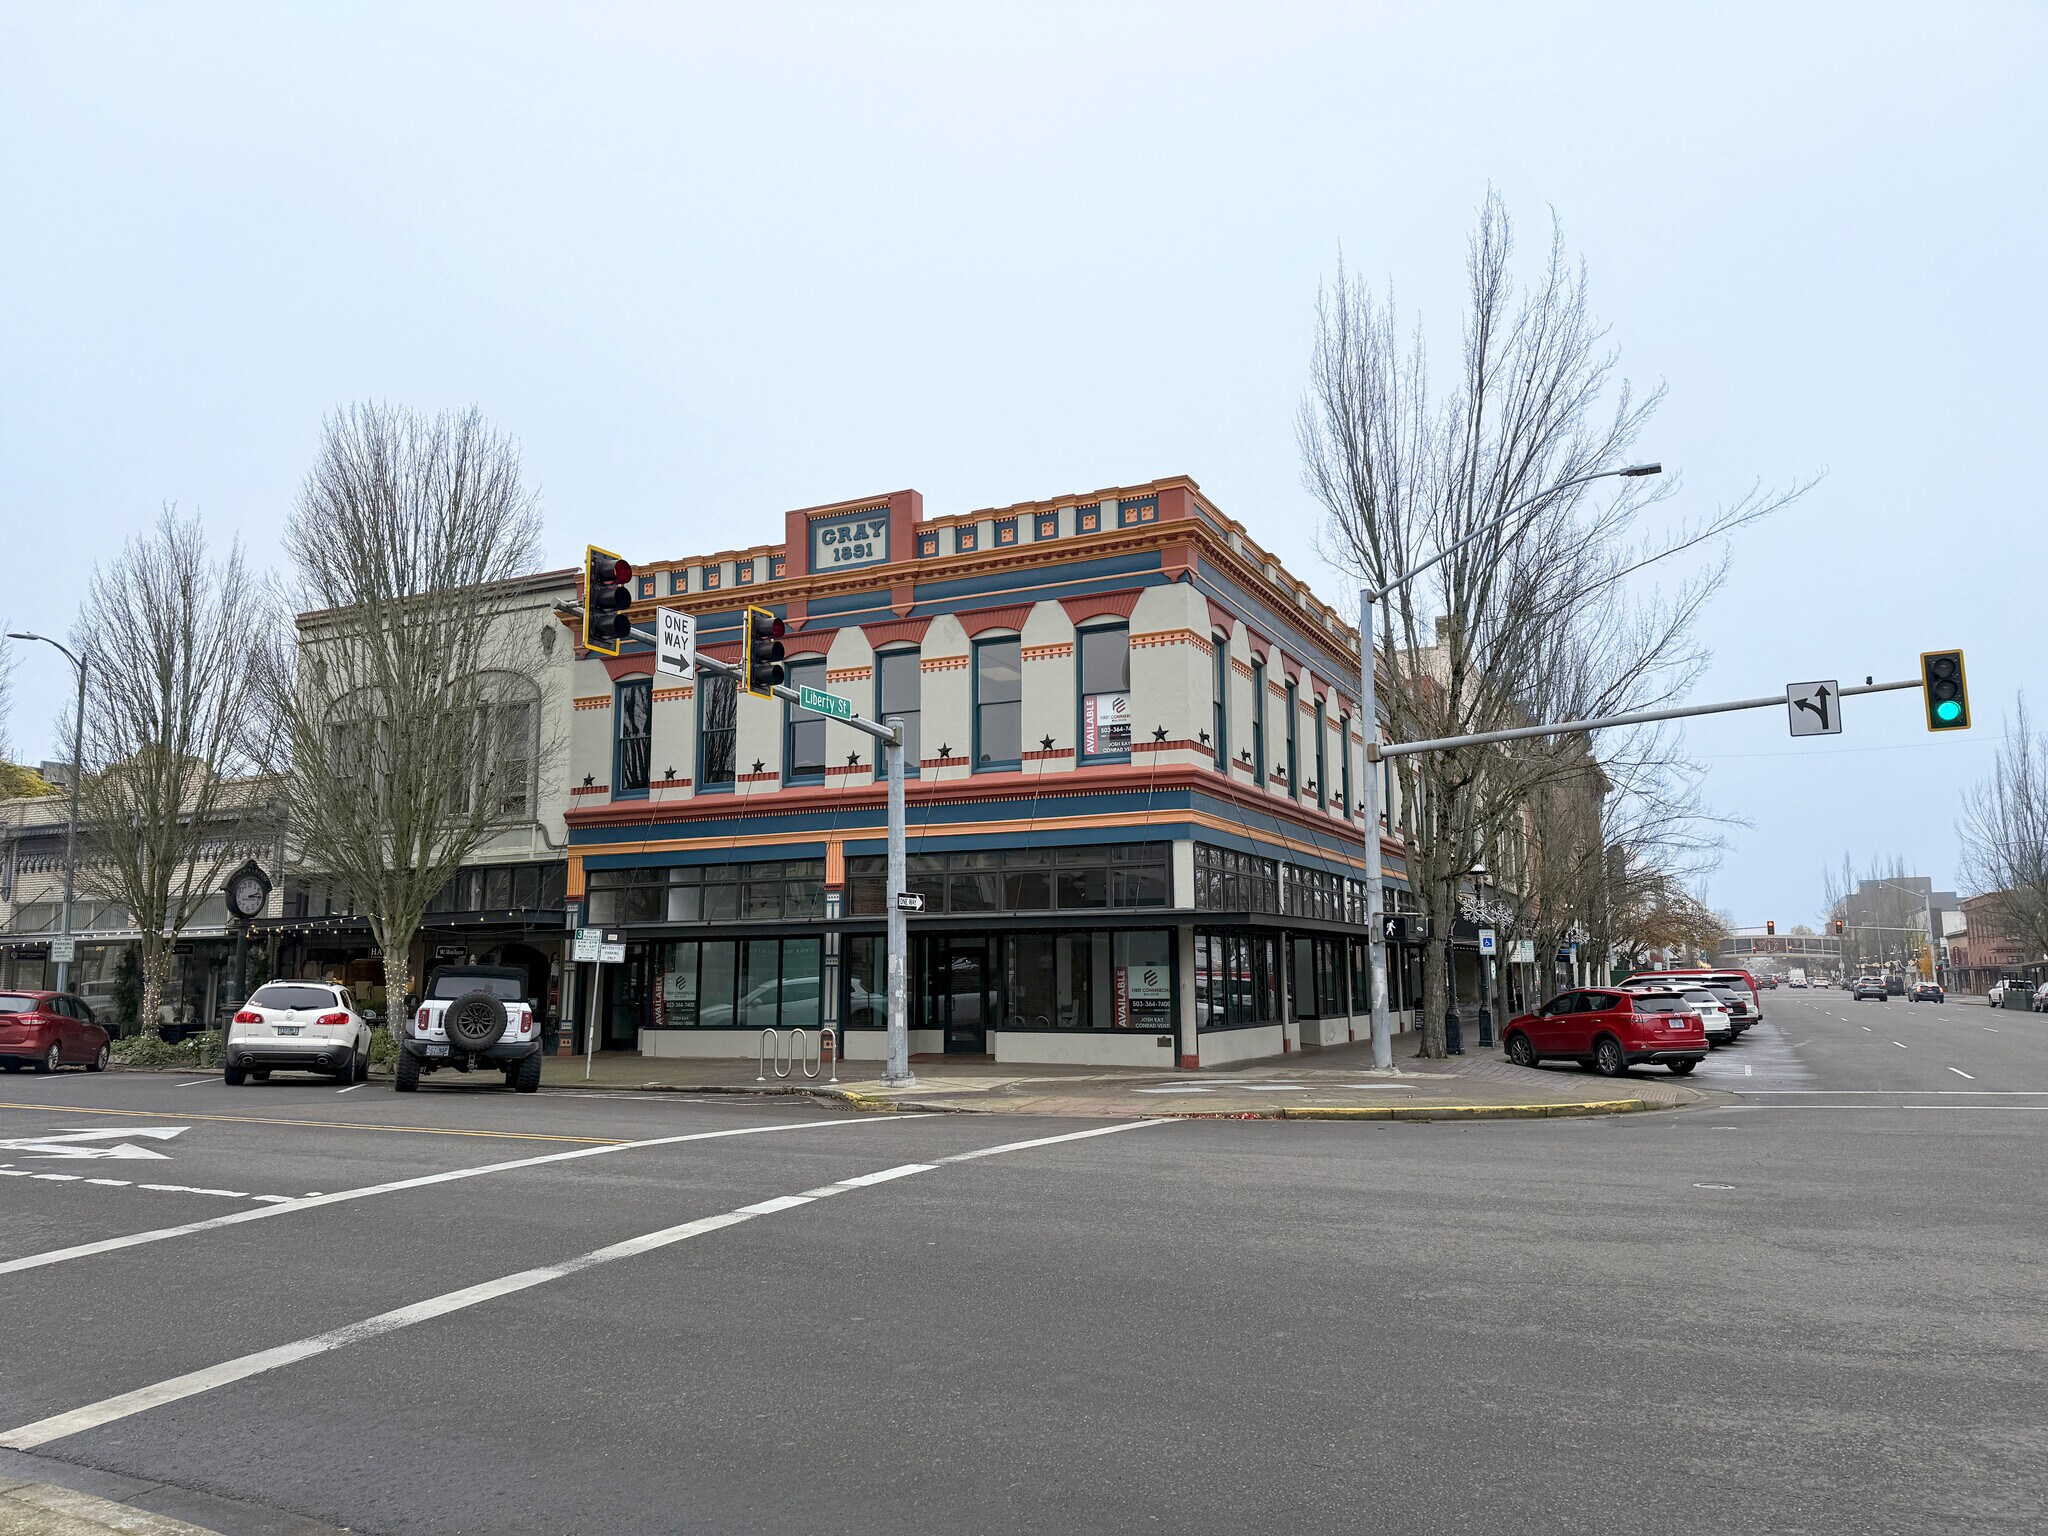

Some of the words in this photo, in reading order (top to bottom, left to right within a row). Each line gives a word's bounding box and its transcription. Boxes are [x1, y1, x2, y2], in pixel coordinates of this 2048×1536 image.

[821, 519, 886, 545] GRAY
[833, 542, 873, 562] 1891
[665, 614, 689, 634] ONE
[664, 631, 689, 650] WAY
[805, 688, 835, 714] Liberty
[838, 699, 847, 714] St
[1086, 700, 1094, 753] AVAILABLE
[577, 930, 583, 939] 3
[1117, 970, 1126, 1027] AVAILABLE
